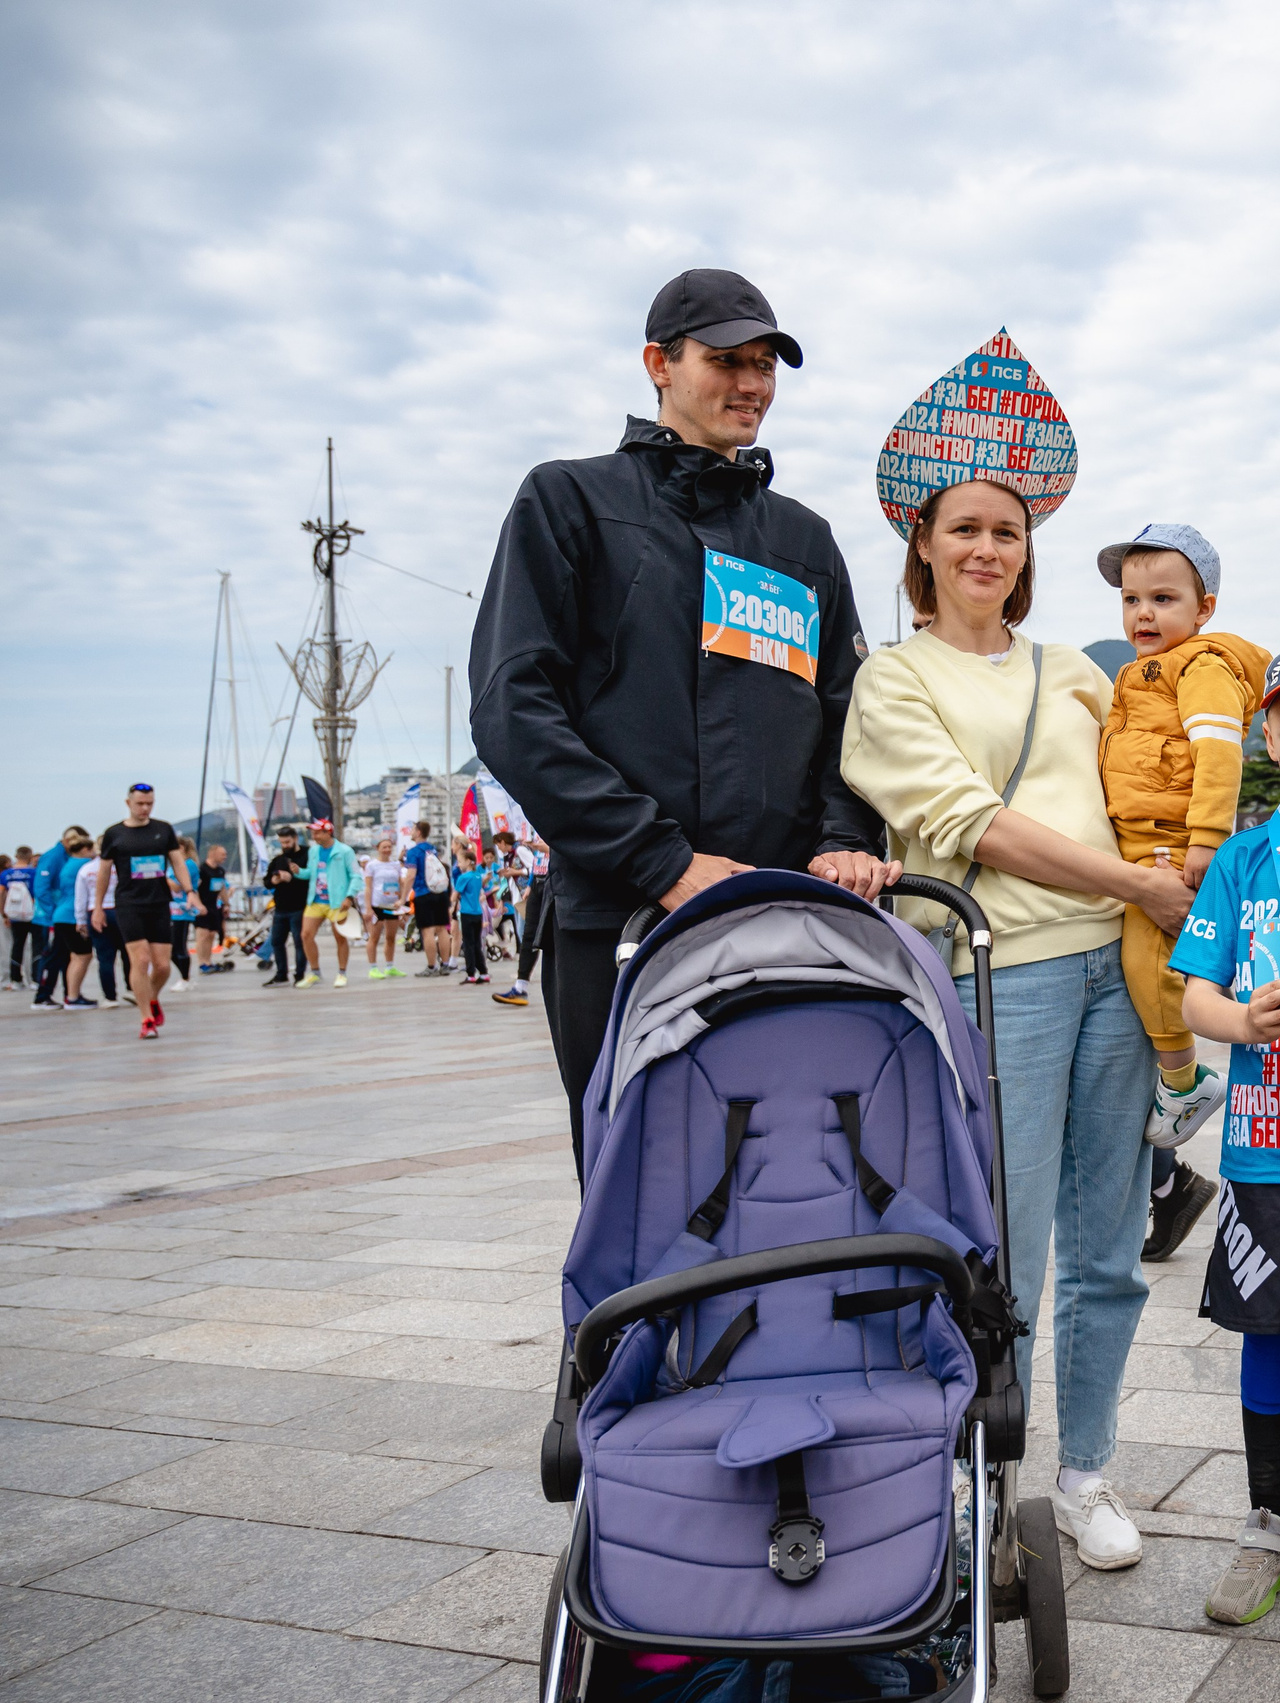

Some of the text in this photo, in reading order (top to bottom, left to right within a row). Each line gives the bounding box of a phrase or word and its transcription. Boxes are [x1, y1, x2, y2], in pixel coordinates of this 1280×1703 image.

[992, 366, 1022, 381] ПСБ
[934, 380, 998, 412] #ЗАБЕГ
[941, 409, 1025, 444] #МОМЕНТ
[876, 453, 909, 480] 024
[725, 559, 745, 572] ПСБ
[729, 590, 805, 645] 20306
[750, 633, 788, 670] 5КМ
